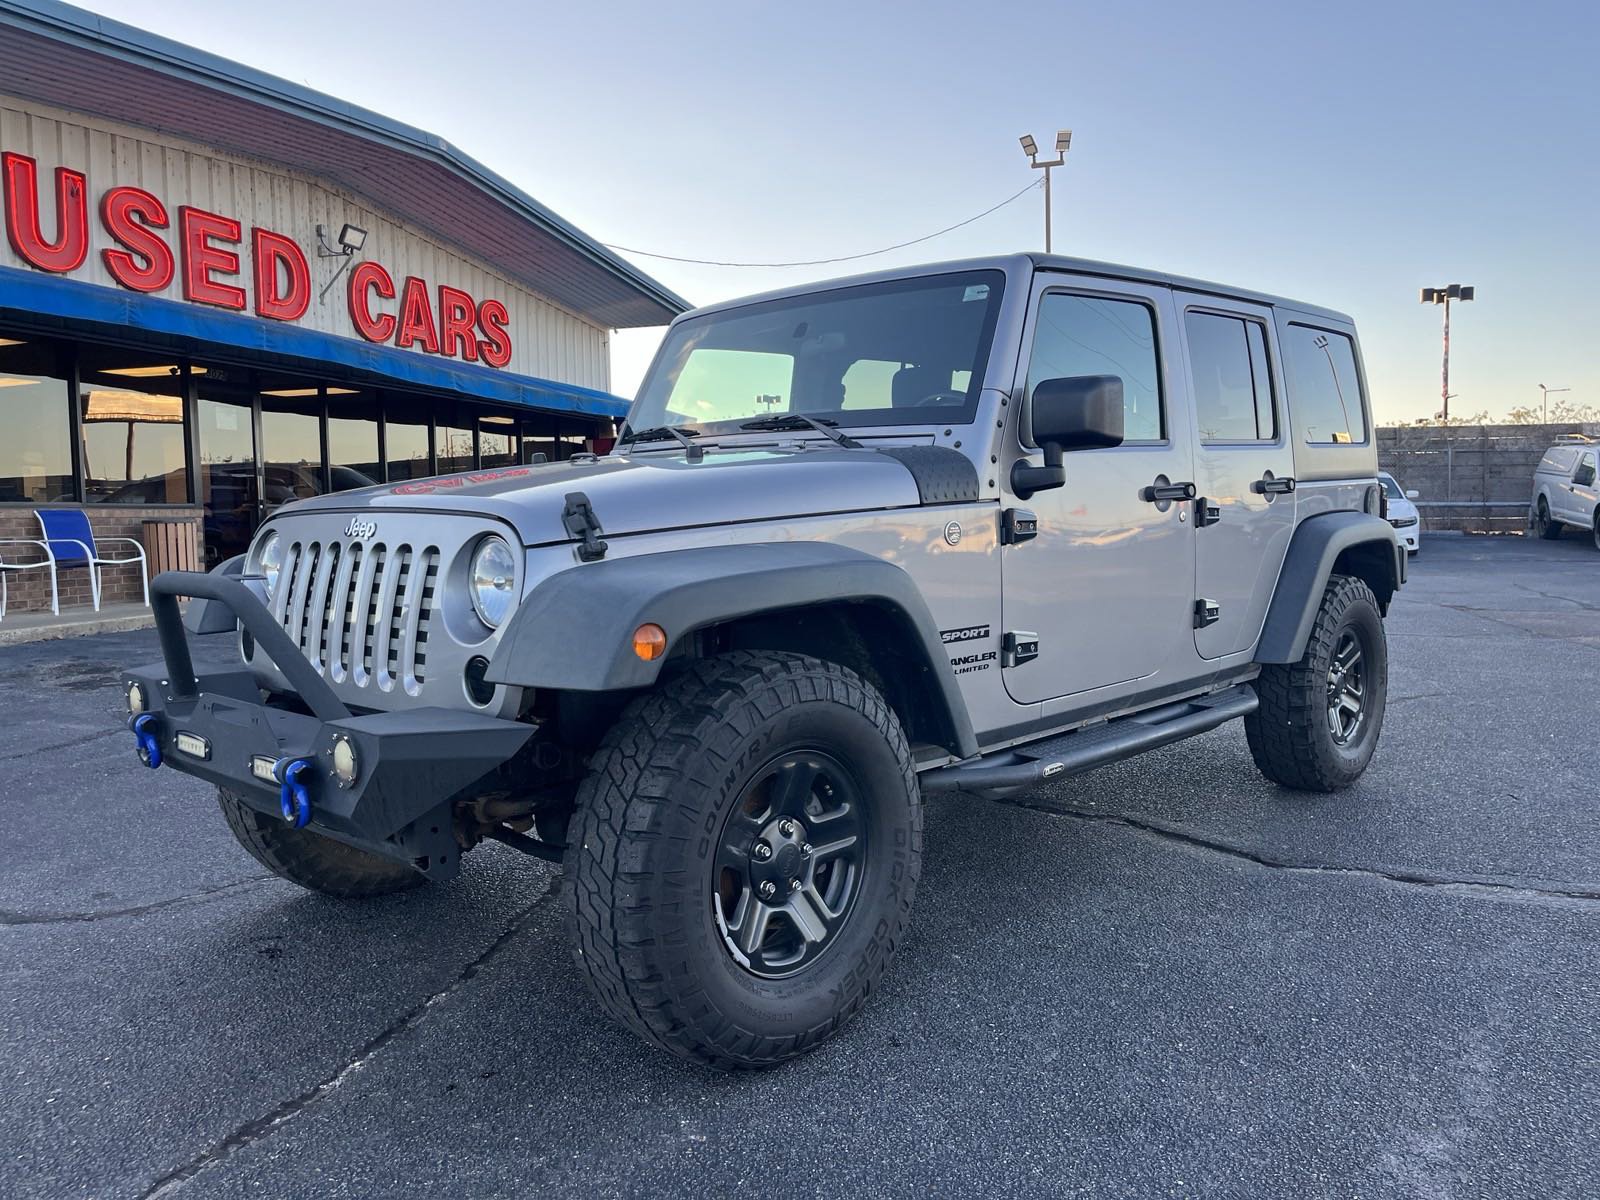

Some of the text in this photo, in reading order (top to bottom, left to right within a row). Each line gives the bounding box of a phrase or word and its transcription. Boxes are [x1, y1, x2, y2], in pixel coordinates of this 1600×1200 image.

[2, 151, 512, 368] USED CARS
[344, 517, 377, 541] Jeep
[942, 626, 989, 642] SPORT
[951, 651, 997, 666] ANGLER
[954, 664, 989, 675] LIMITED
[697, 725, 777, 860] COUNTRY
[828, 828, 907, 1001] DICK CEPEK
